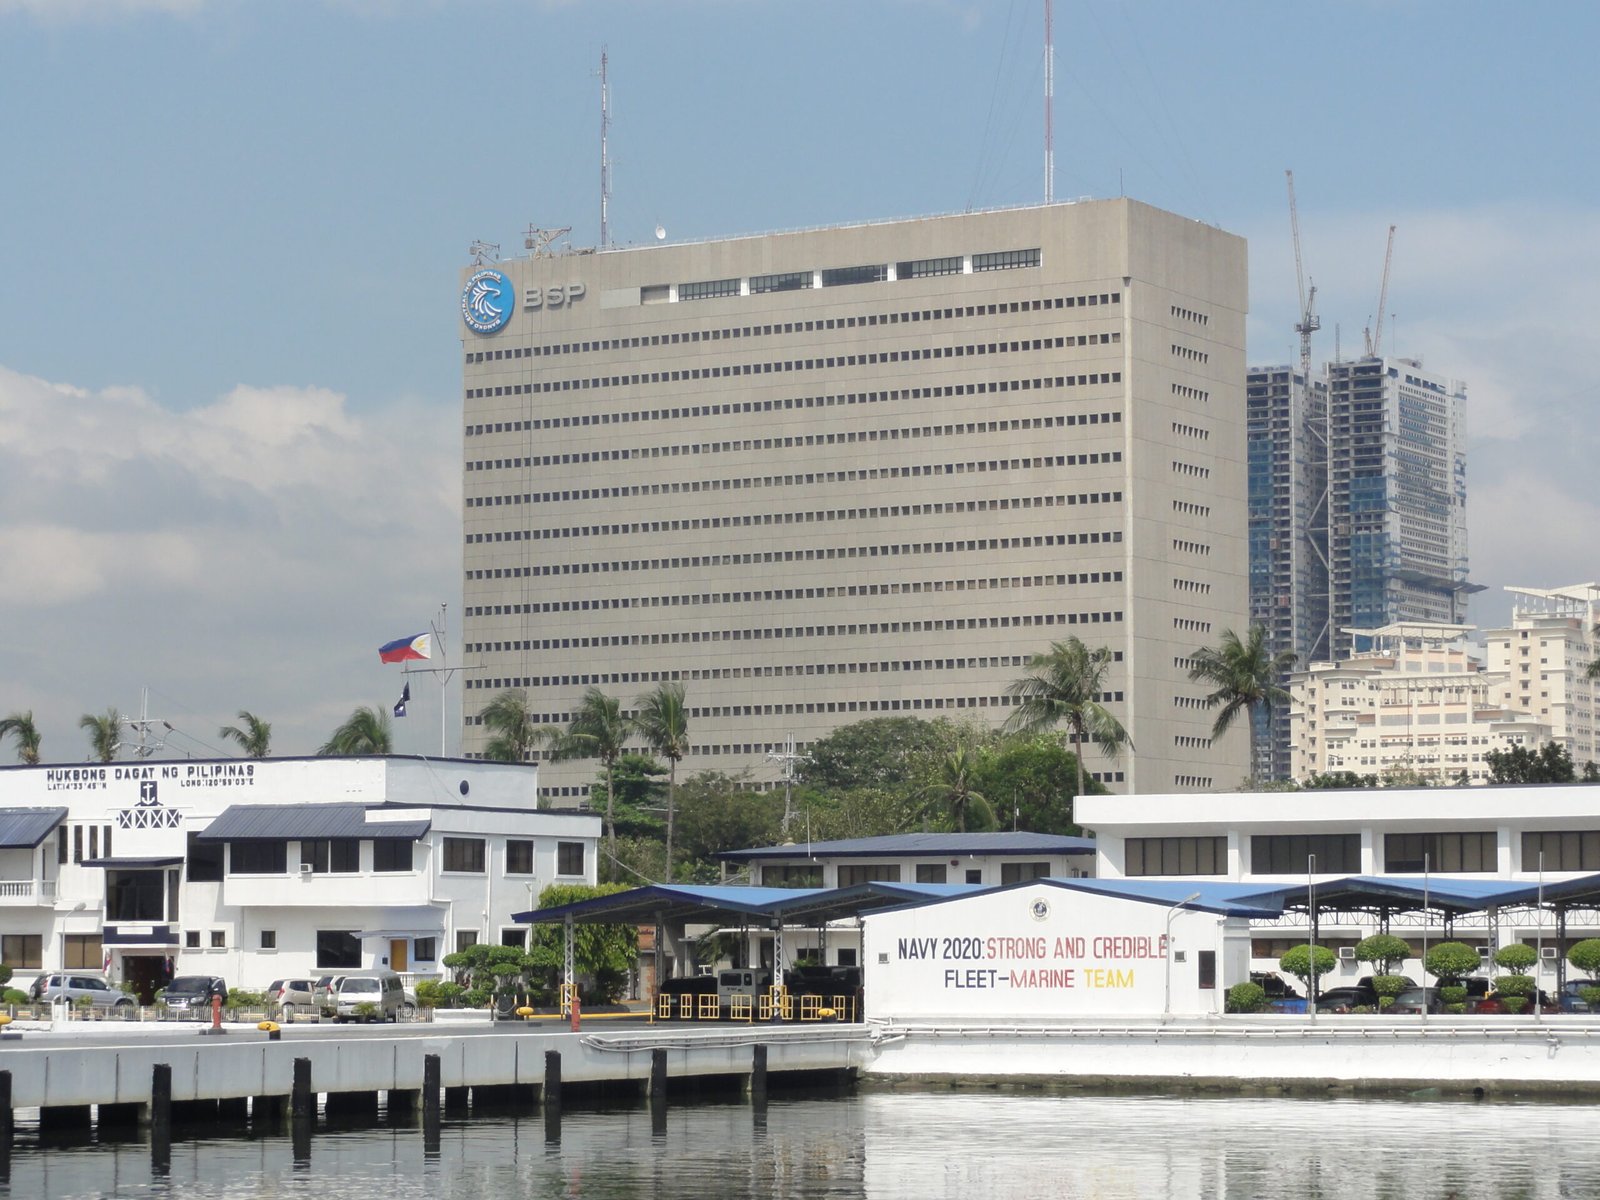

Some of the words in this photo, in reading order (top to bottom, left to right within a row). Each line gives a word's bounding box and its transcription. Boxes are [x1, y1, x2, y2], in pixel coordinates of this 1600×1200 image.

[524, 281, 586, 309] BSP
[47, 769, 106, 782] HUKBONG
[115, 767, 155, 780] DAGAT
[162, 766, 178, 779] NG
[187, 764, 254, 778] PILIPINAS
[898, 937, 938, 960] NAVY
[987, 937, 1047, 960] STRONG
[1053, 937, 1086, 959] AND
[1093, 936, 1168, 959] CREDIBLE
[1083, 969, 1135, 988] TEAM
